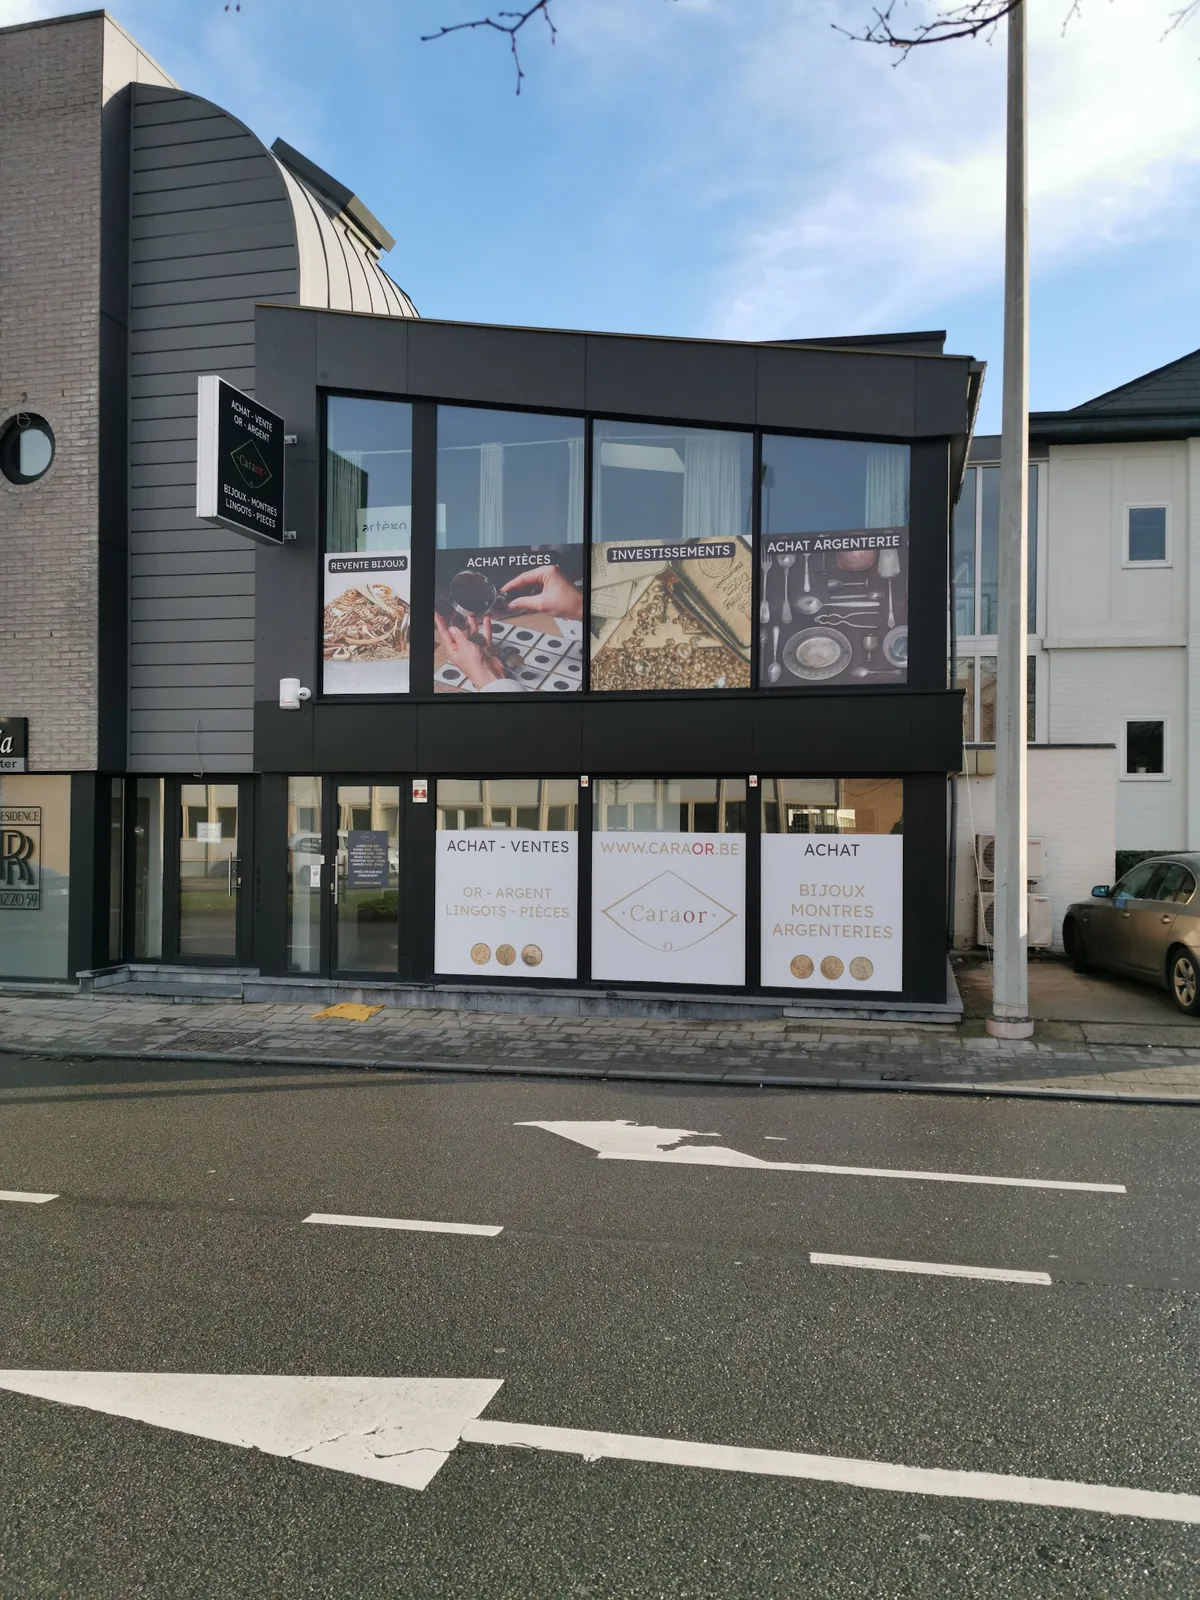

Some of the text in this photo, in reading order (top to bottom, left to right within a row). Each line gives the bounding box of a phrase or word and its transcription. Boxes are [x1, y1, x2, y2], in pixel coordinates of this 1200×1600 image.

[231, 400, 250, 418] ACHAT
[254, 414, 273, 433] VENTE
[233, 414, 243, 426] OR
[247, 423, 270, 443] ARGENT
[239, 454, 264, 477] Caraor
[223, 484, 247, 503] BIJOUX
[251, 498, 278, 517] MONTRES
[225, 498, 252, 518] LINGOTS
[256, 513, 276, 529] PIECES
[767, 535, 900, 553] ACHAT ARGENTERIE
[467, 553, 551, 568] ACHAT PIÈCES
[612, 545, 731, 561] INVESTISSEMENTS
[331, 558, 405, 570] REVENTE BIJOUX
[0, 811, 39, 821] ESIDENCE
[447, 840, 496, 852] ACHAT
[510, 840, 570, 853] VENTES
[600, 841, 740, 856] WWW.CARAOR.BE
[804, 844, 860, 857] ACHAT
[462, 887, 482, 898] OR
[495, 888, 552, 899] ARGENT
[799, 884, 865, 897] BIJOUX
[27, 893, 38, 907] 59
[446, 905, 507, 917] LINGOTS
[520, 904, 570, 918] PIÈCES
[630, 904, 708, 923] Caraor
[791, 904, 874, 918] MONTRES
[772, 923, 893, 939] ARGENTERIES
